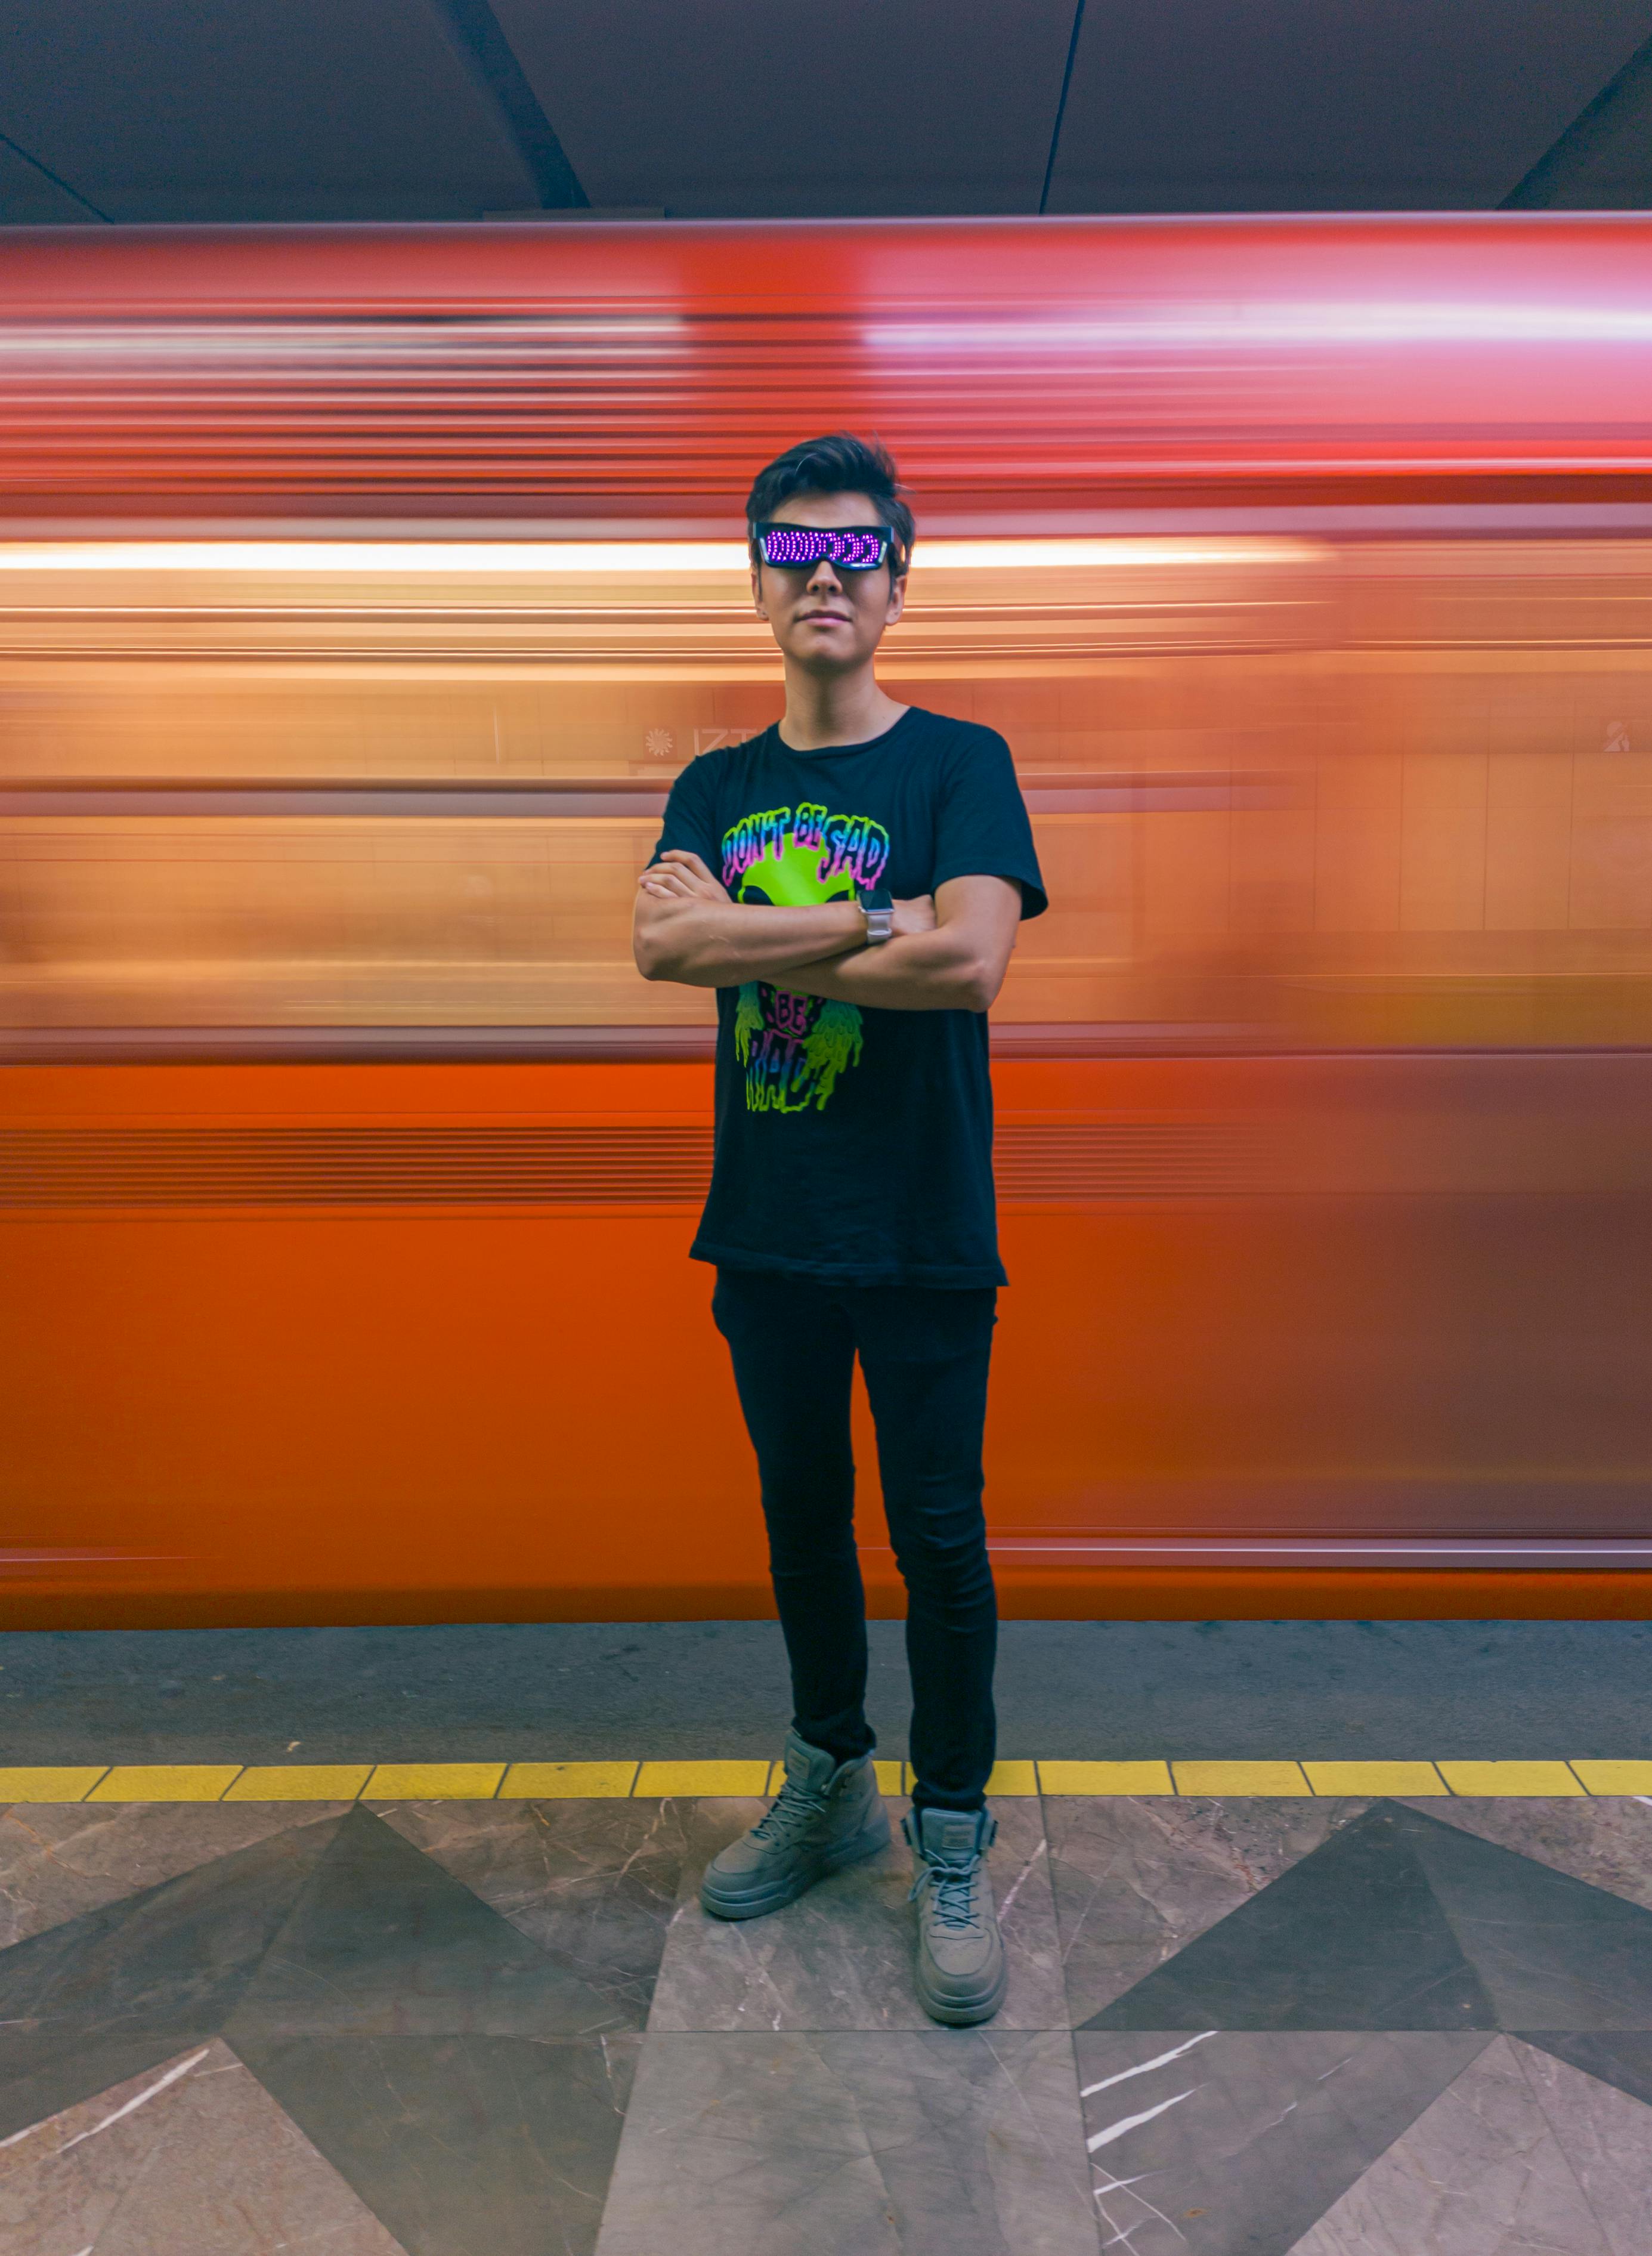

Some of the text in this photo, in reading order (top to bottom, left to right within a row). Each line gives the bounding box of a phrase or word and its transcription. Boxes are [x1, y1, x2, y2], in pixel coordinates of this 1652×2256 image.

[722, 802, 890, 890] DON'T BE SAD
[775, 990, 808, 1035] BE
